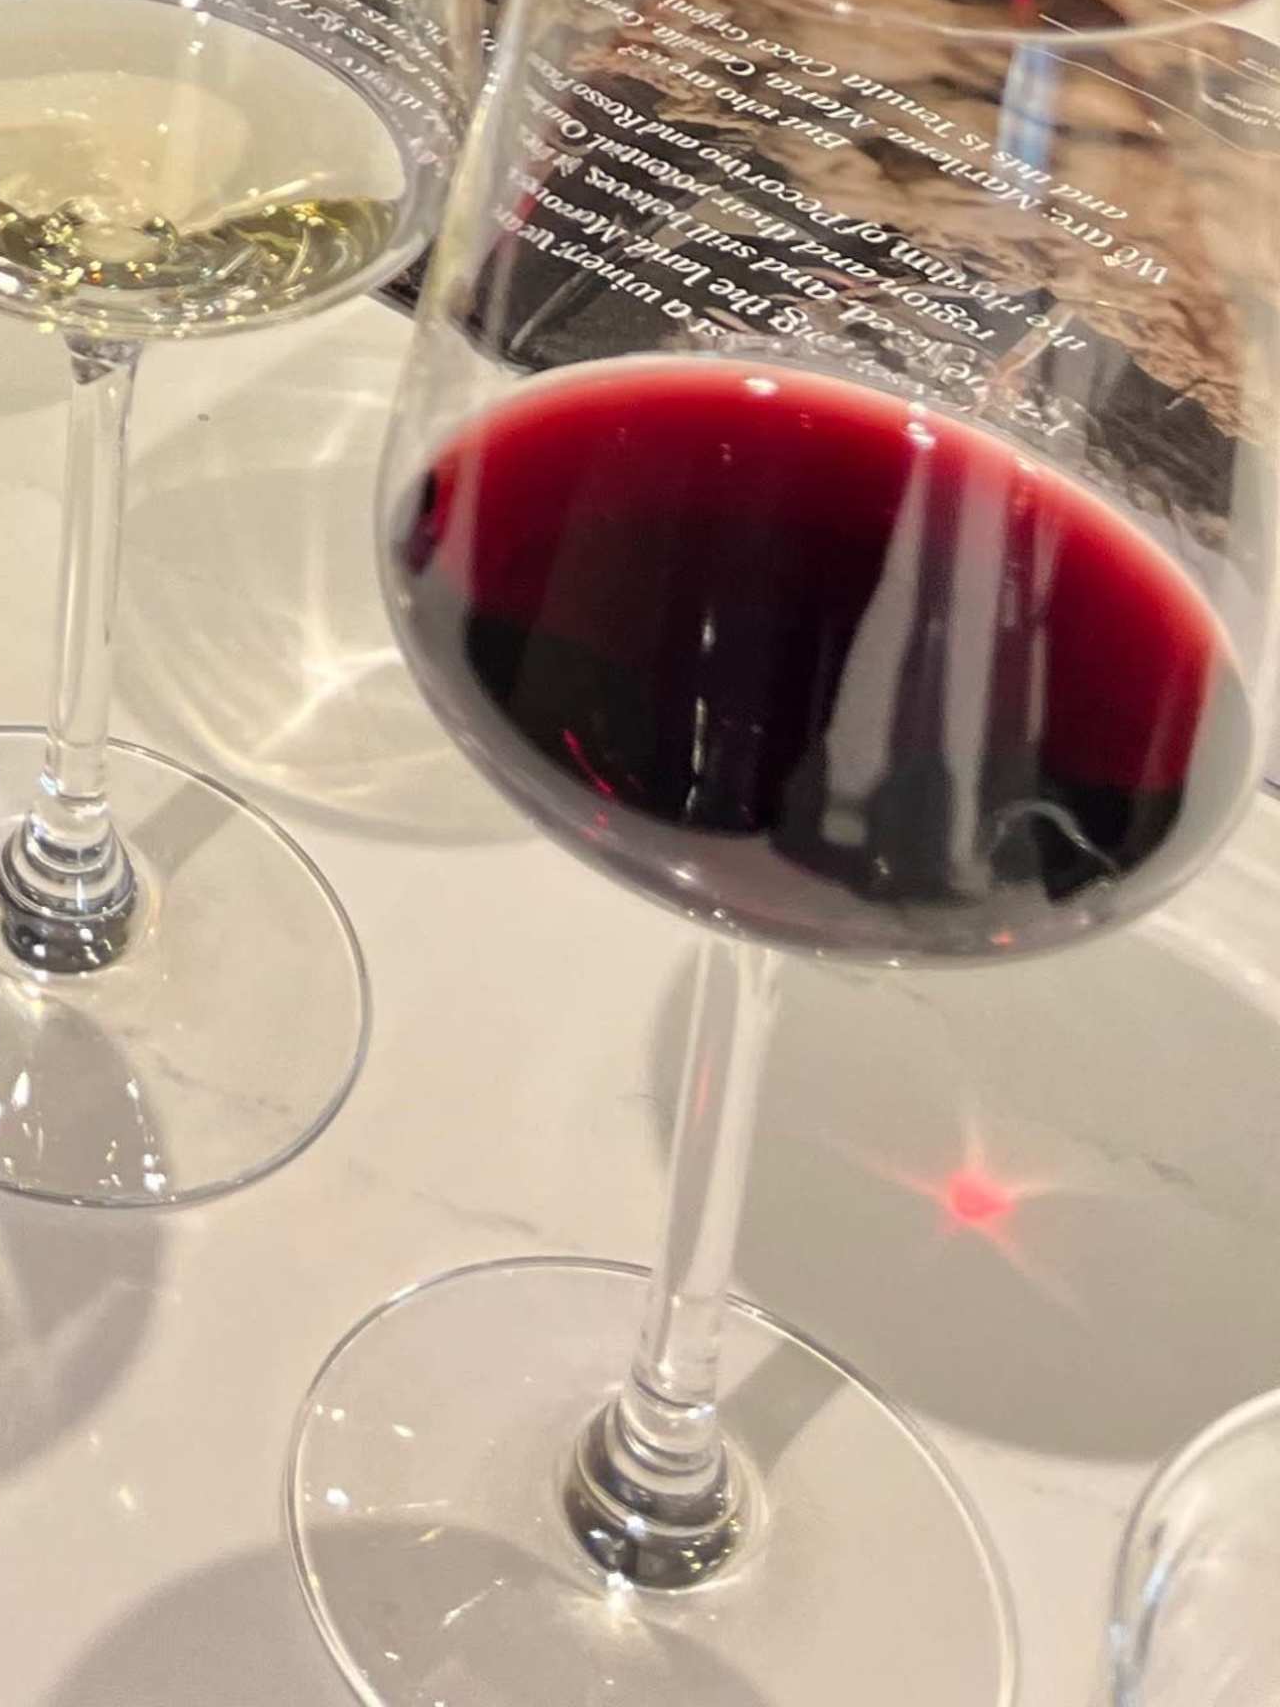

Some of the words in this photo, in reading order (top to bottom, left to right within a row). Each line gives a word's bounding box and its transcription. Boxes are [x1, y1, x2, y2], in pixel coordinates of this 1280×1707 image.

[665, 61, 719, 89] are
[746, 32, 839, 80] Cocci
[565, 85, 646, 128] Rosso
[711, 86, 781, 123] who
[837, 73, 957, 134] Tenuta
[634, 119, 701, 154] and
[775, 113, 852, 153] But
[954, 133, 992, 153] is
[692, 148, 851, 227] Pecorino
[988, 151, 1054, 185] this
[705, 194, 798, 243] their
[1047, 181, 1129, 223] and
[684, 222, 760, 261] still
[832, 213, 891, 246] of
[746, 254, 840, 302] and
[787, 237, 879, 284] and
[1100, 243, 1170, 281] We
[704, 279, 772, 316] the
[866, 273, 1000, 341] region
[1020, 314, 1090, 352] the
